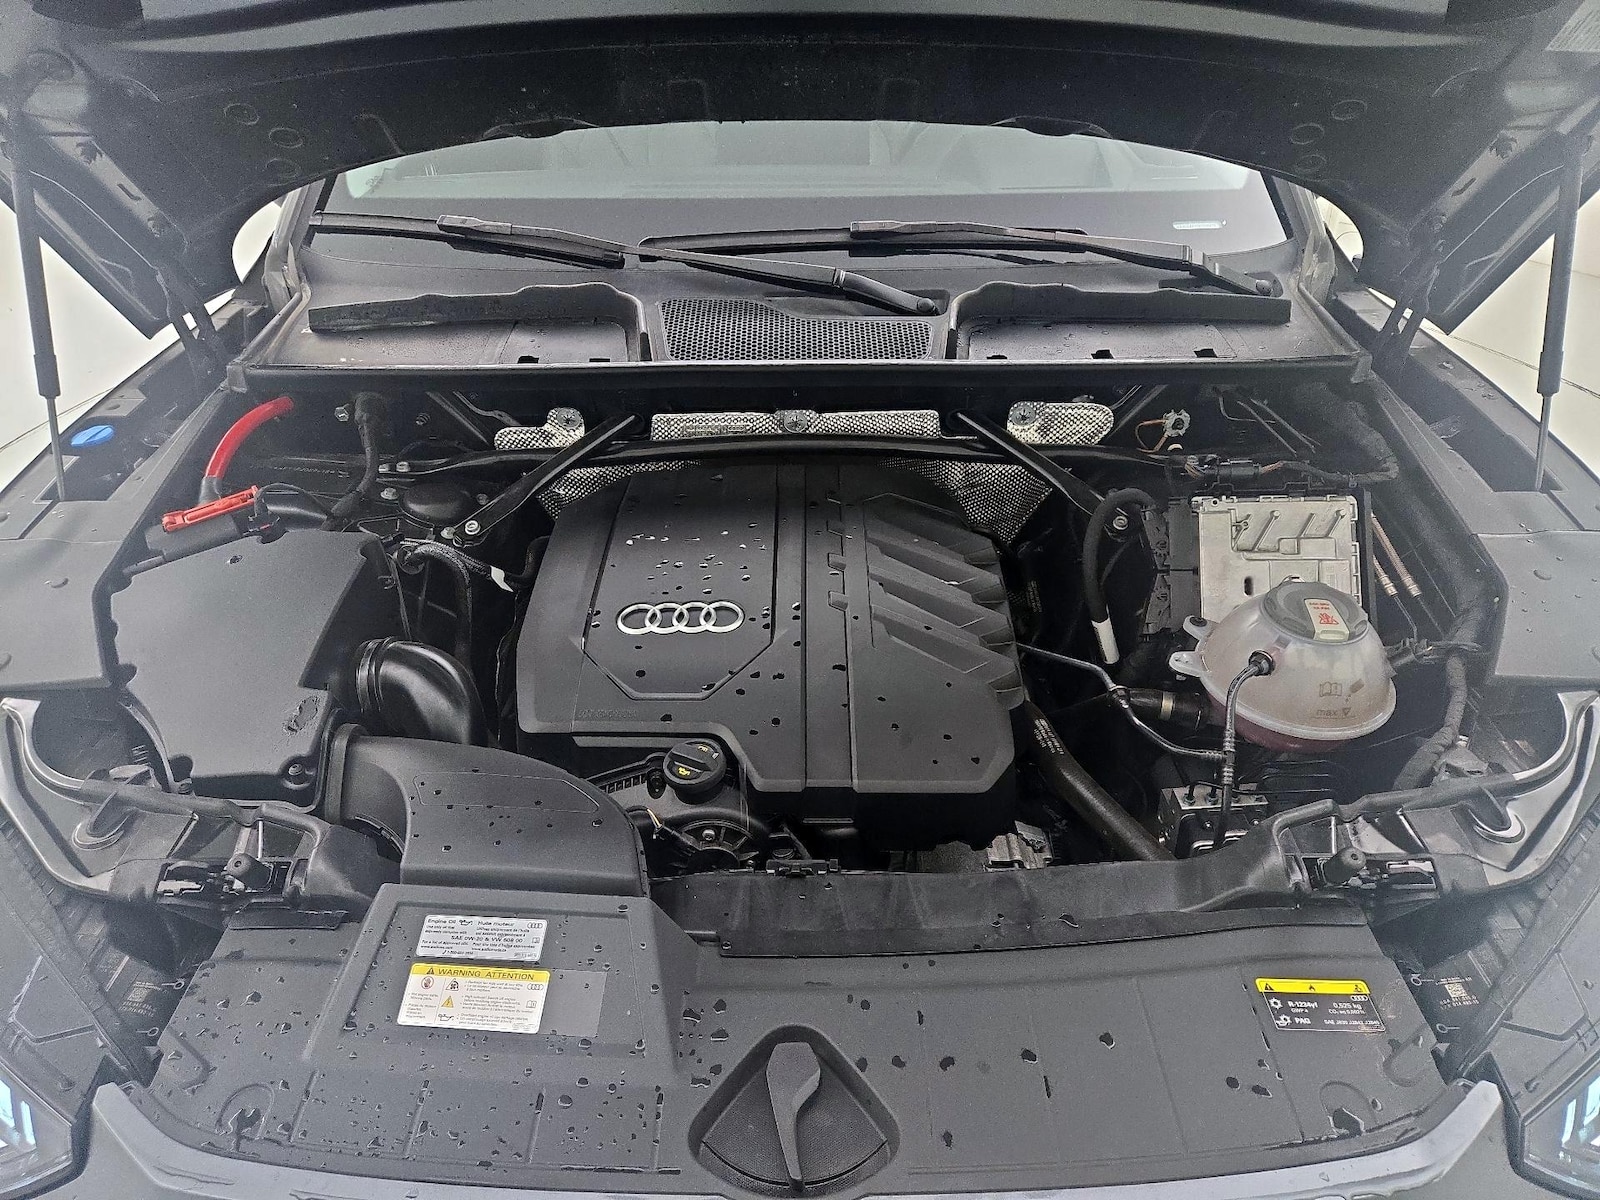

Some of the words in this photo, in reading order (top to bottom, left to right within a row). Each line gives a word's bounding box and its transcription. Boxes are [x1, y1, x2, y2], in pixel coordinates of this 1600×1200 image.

[1316, 708, 1338, 717] max
[438, 968, 481, 977] WARNING
[485, 971, 535, 980] ATTENTION
[1352, 1002, 1362, 1010] kg
